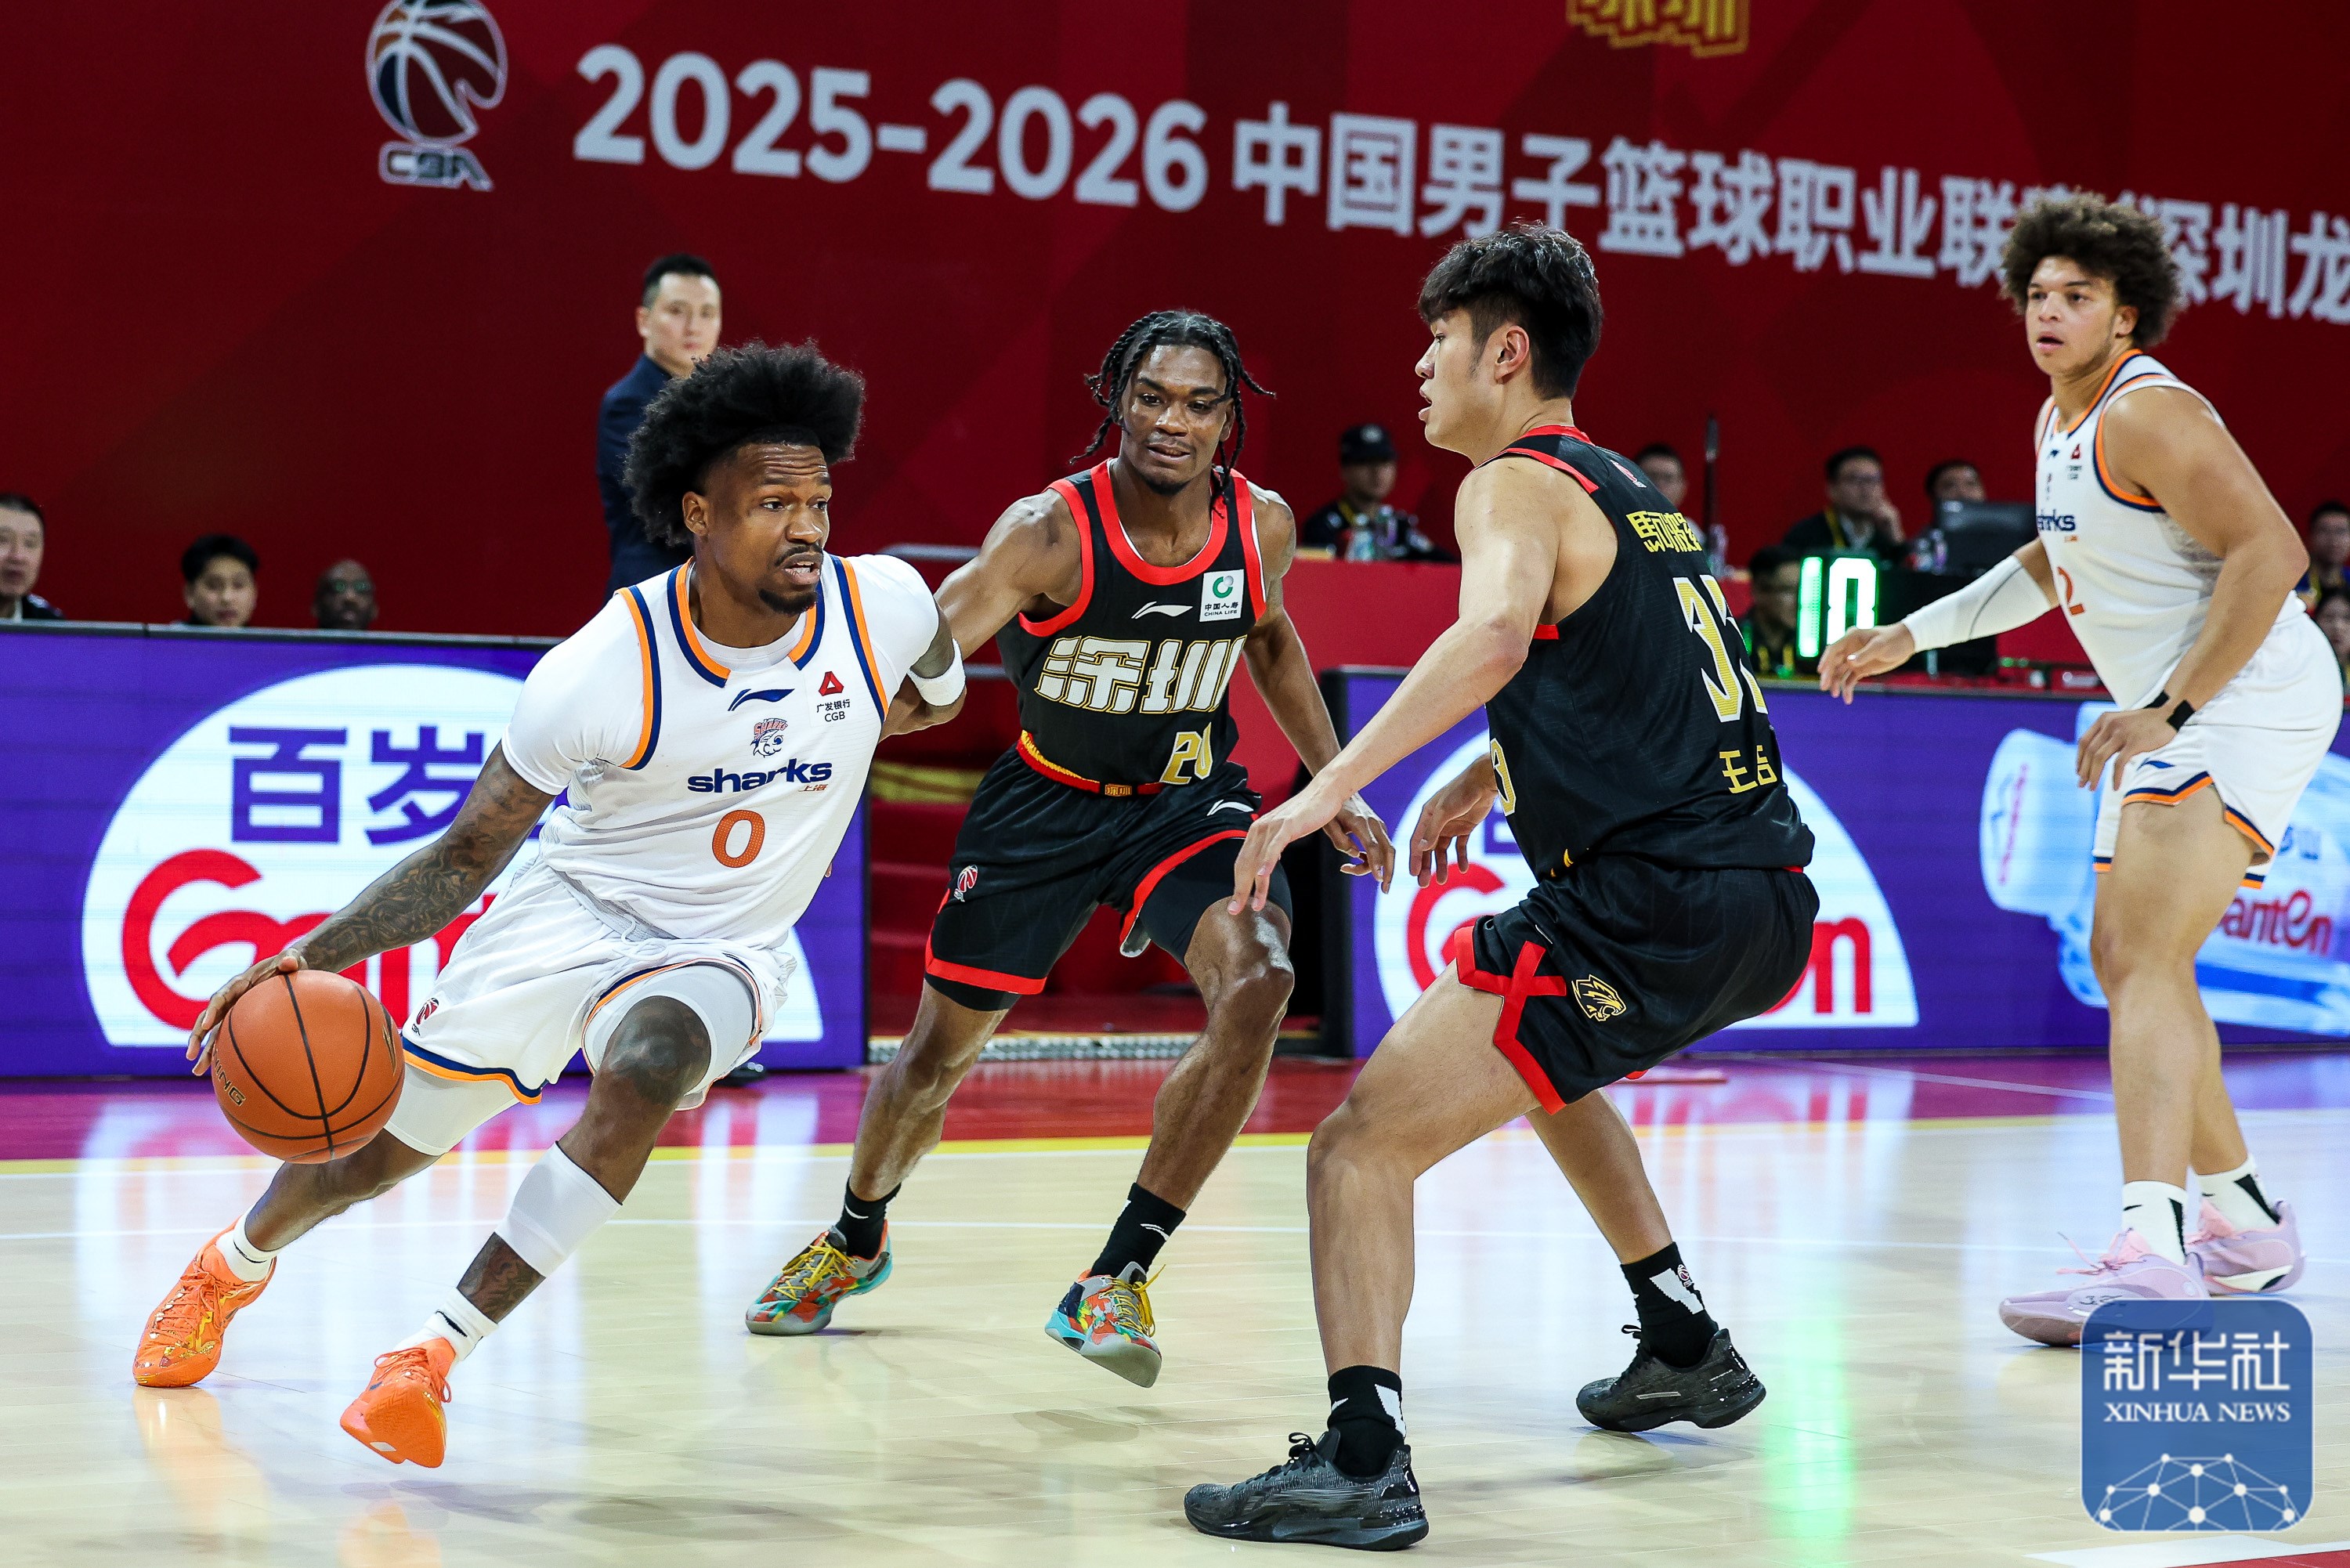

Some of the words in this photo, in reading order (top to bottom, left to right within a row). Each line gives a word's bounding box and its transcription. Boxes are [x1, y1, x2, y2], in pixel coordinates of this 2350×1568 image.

[573, 43, 1208, 213] 2025-2026
[1204, 602, 1238, 611] 中国人寿
[1033, 634, 1247, 714] 深圳
[816, 699, 851, 713] 广发银行
[824, 710, 845, 722] CGB
[230, 725, 569, 846] 百岁
[688, 758, 833, 793] sharks
[712, 809, 765, 869] 0
[2218, 889, 2334, 957] anten
